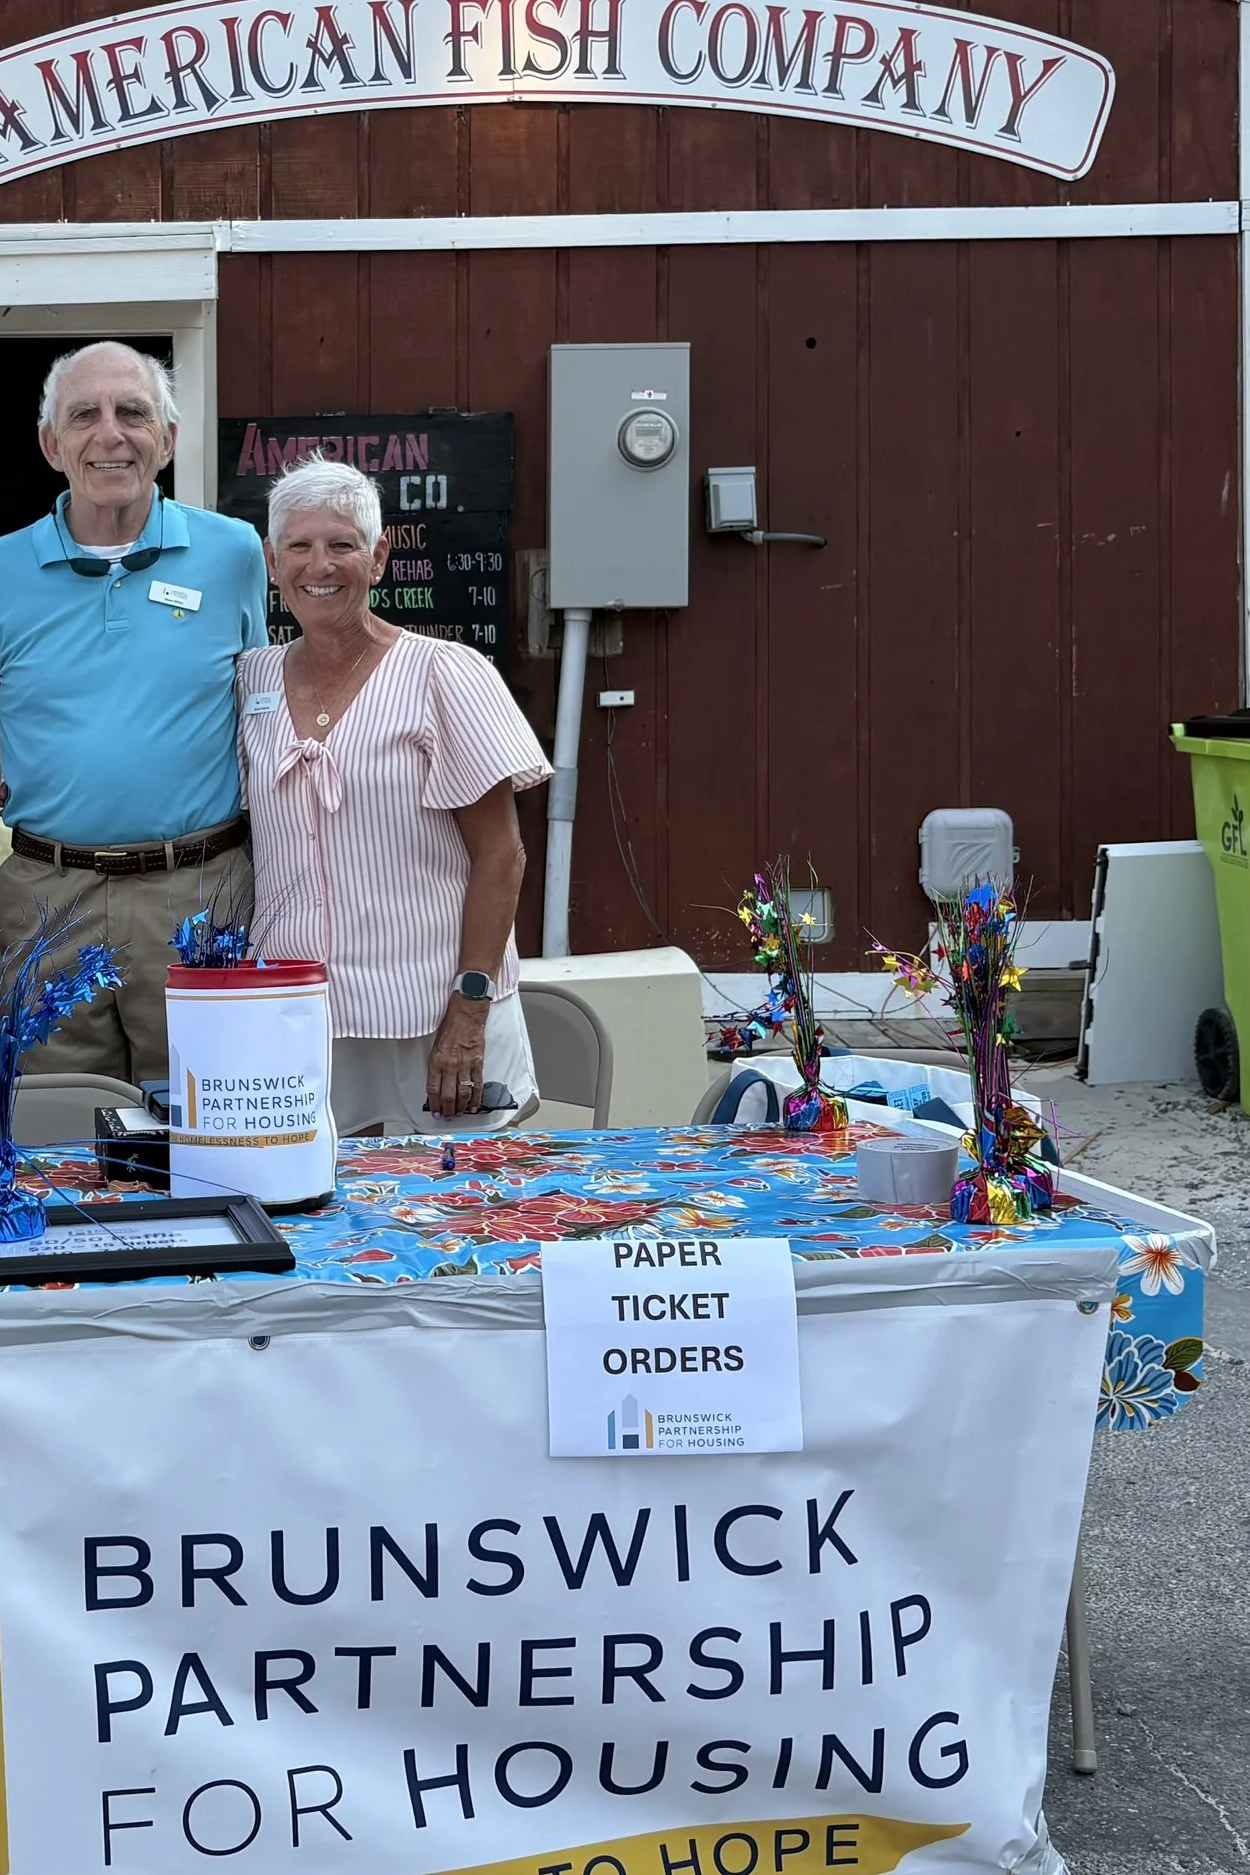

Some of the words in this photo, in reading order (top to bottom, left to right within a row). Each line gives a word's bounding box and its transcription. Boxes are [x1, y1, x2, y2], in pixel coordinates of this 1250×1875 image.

[443, 0, 627, 82] FISH
[658, 0, 1067, 143] COMPANY
[236, 423, 429, 476] AMERICAN
[392, 559, 434, 582] REHAB
[394, 587, 434, 609] CREEK
[468, 586, 496, 606] 7-10
[268, 625, 294, 645] SAT
[472, 624, 496, 644] 7-10
[202, 1075, 305, 1092] BRUNSWICK
[203, 1093, 315, 1111] PARTNERSHIP
[203, 1117, 236, 1130] FOR
[245, 1111, 317, 1130] HOUSING
[265, 1136, 279, 1145] TO
[283, 1132, 310, 1143] HOPE
[30, 1235, 103, 1246] 50/50
[614, 1241, 722, 1268] PAPER
[611, 1293, 729, 1321] TICKET
[603, 1345, 744, 1375] ORDERS
[658, 1413, 732, 1424] BRUNSWICK
[658, 1425, 742, 1436] PARTNERSHIP
[659, 1439, 683, 1448] FOR
[688, 1437, 745, 1447] HOUSING
[83, 1489, 860, 1612] BRUNSWICK
[93, 1594, 932, 1743] PARTNERSHIP
[101, 1764, 352, 1866] FOR
[403, 1711, 970, 1828] HOUSING
[659, 1824, 860, 1875] HOPE
